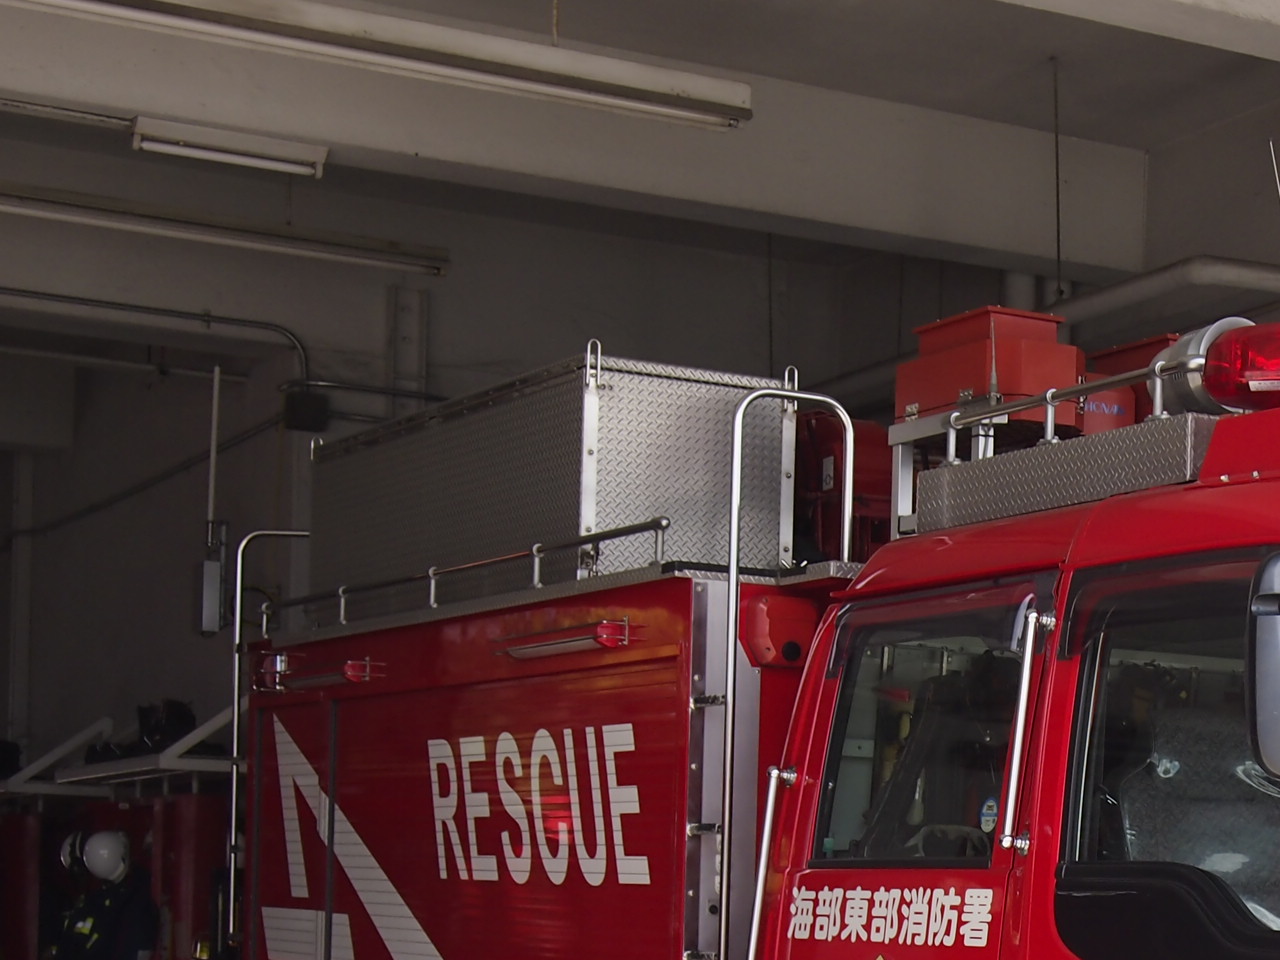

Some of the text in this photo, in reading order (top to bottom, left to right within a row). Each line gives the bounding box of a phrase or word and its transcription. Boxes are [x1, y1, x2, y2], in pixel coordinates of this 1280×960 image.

[426, 722, 652, 887] RESCUE
[786, 884, 995, 948] 海部東部消防署
